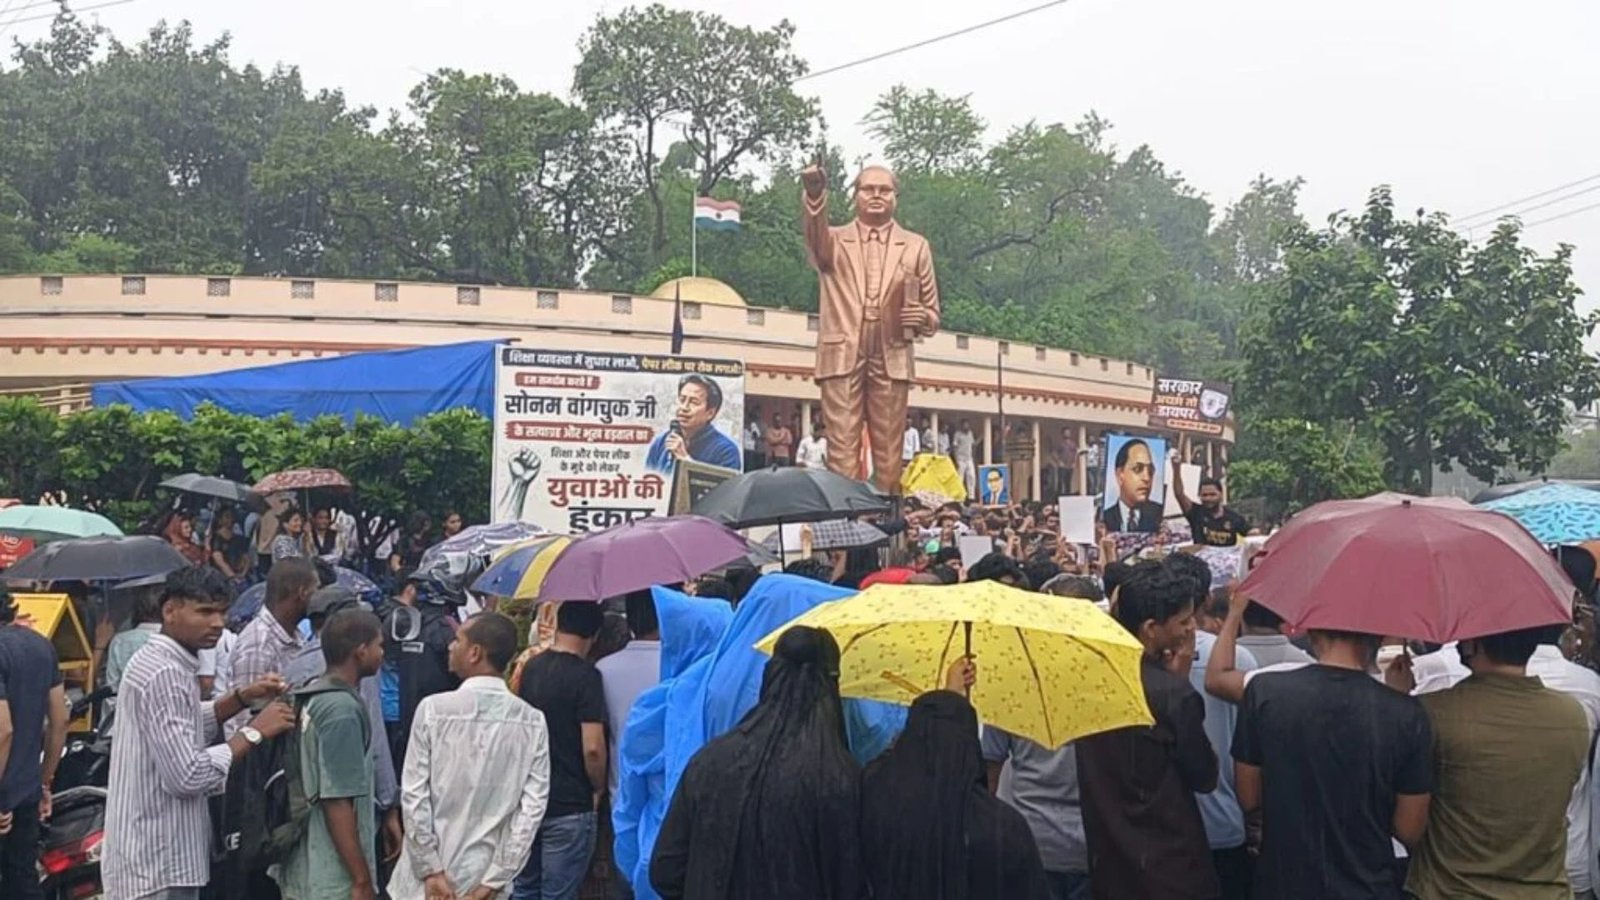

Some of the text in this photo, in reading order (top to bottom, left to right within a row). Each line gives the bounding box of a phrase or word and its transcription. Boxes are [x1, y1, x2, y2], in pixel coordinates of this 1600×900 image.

[509, 349, 535, 363] शिक्षा
[537, 353, 572, 365] व्यवस्था
[574, 352, 584, 365] में
[584, 354, 610, 369] सुधार
[504, 389, 657, 424] सोनम वांगचुक जी
[513, 422, 523, 437] के
[562, 425, 581, 439] और
[636, 430, 649, 441] का
[551, 447, 573, 459] शिक्षा
[576, 447, 591, 459] और
[593, 448, 610, 459] पेपर
[560, 461, 568, 471] के
[586, 461, 597, 472] को
[599, 461, 620, 472] लेकर
[547, 473, 665, 508] युवाओं की
